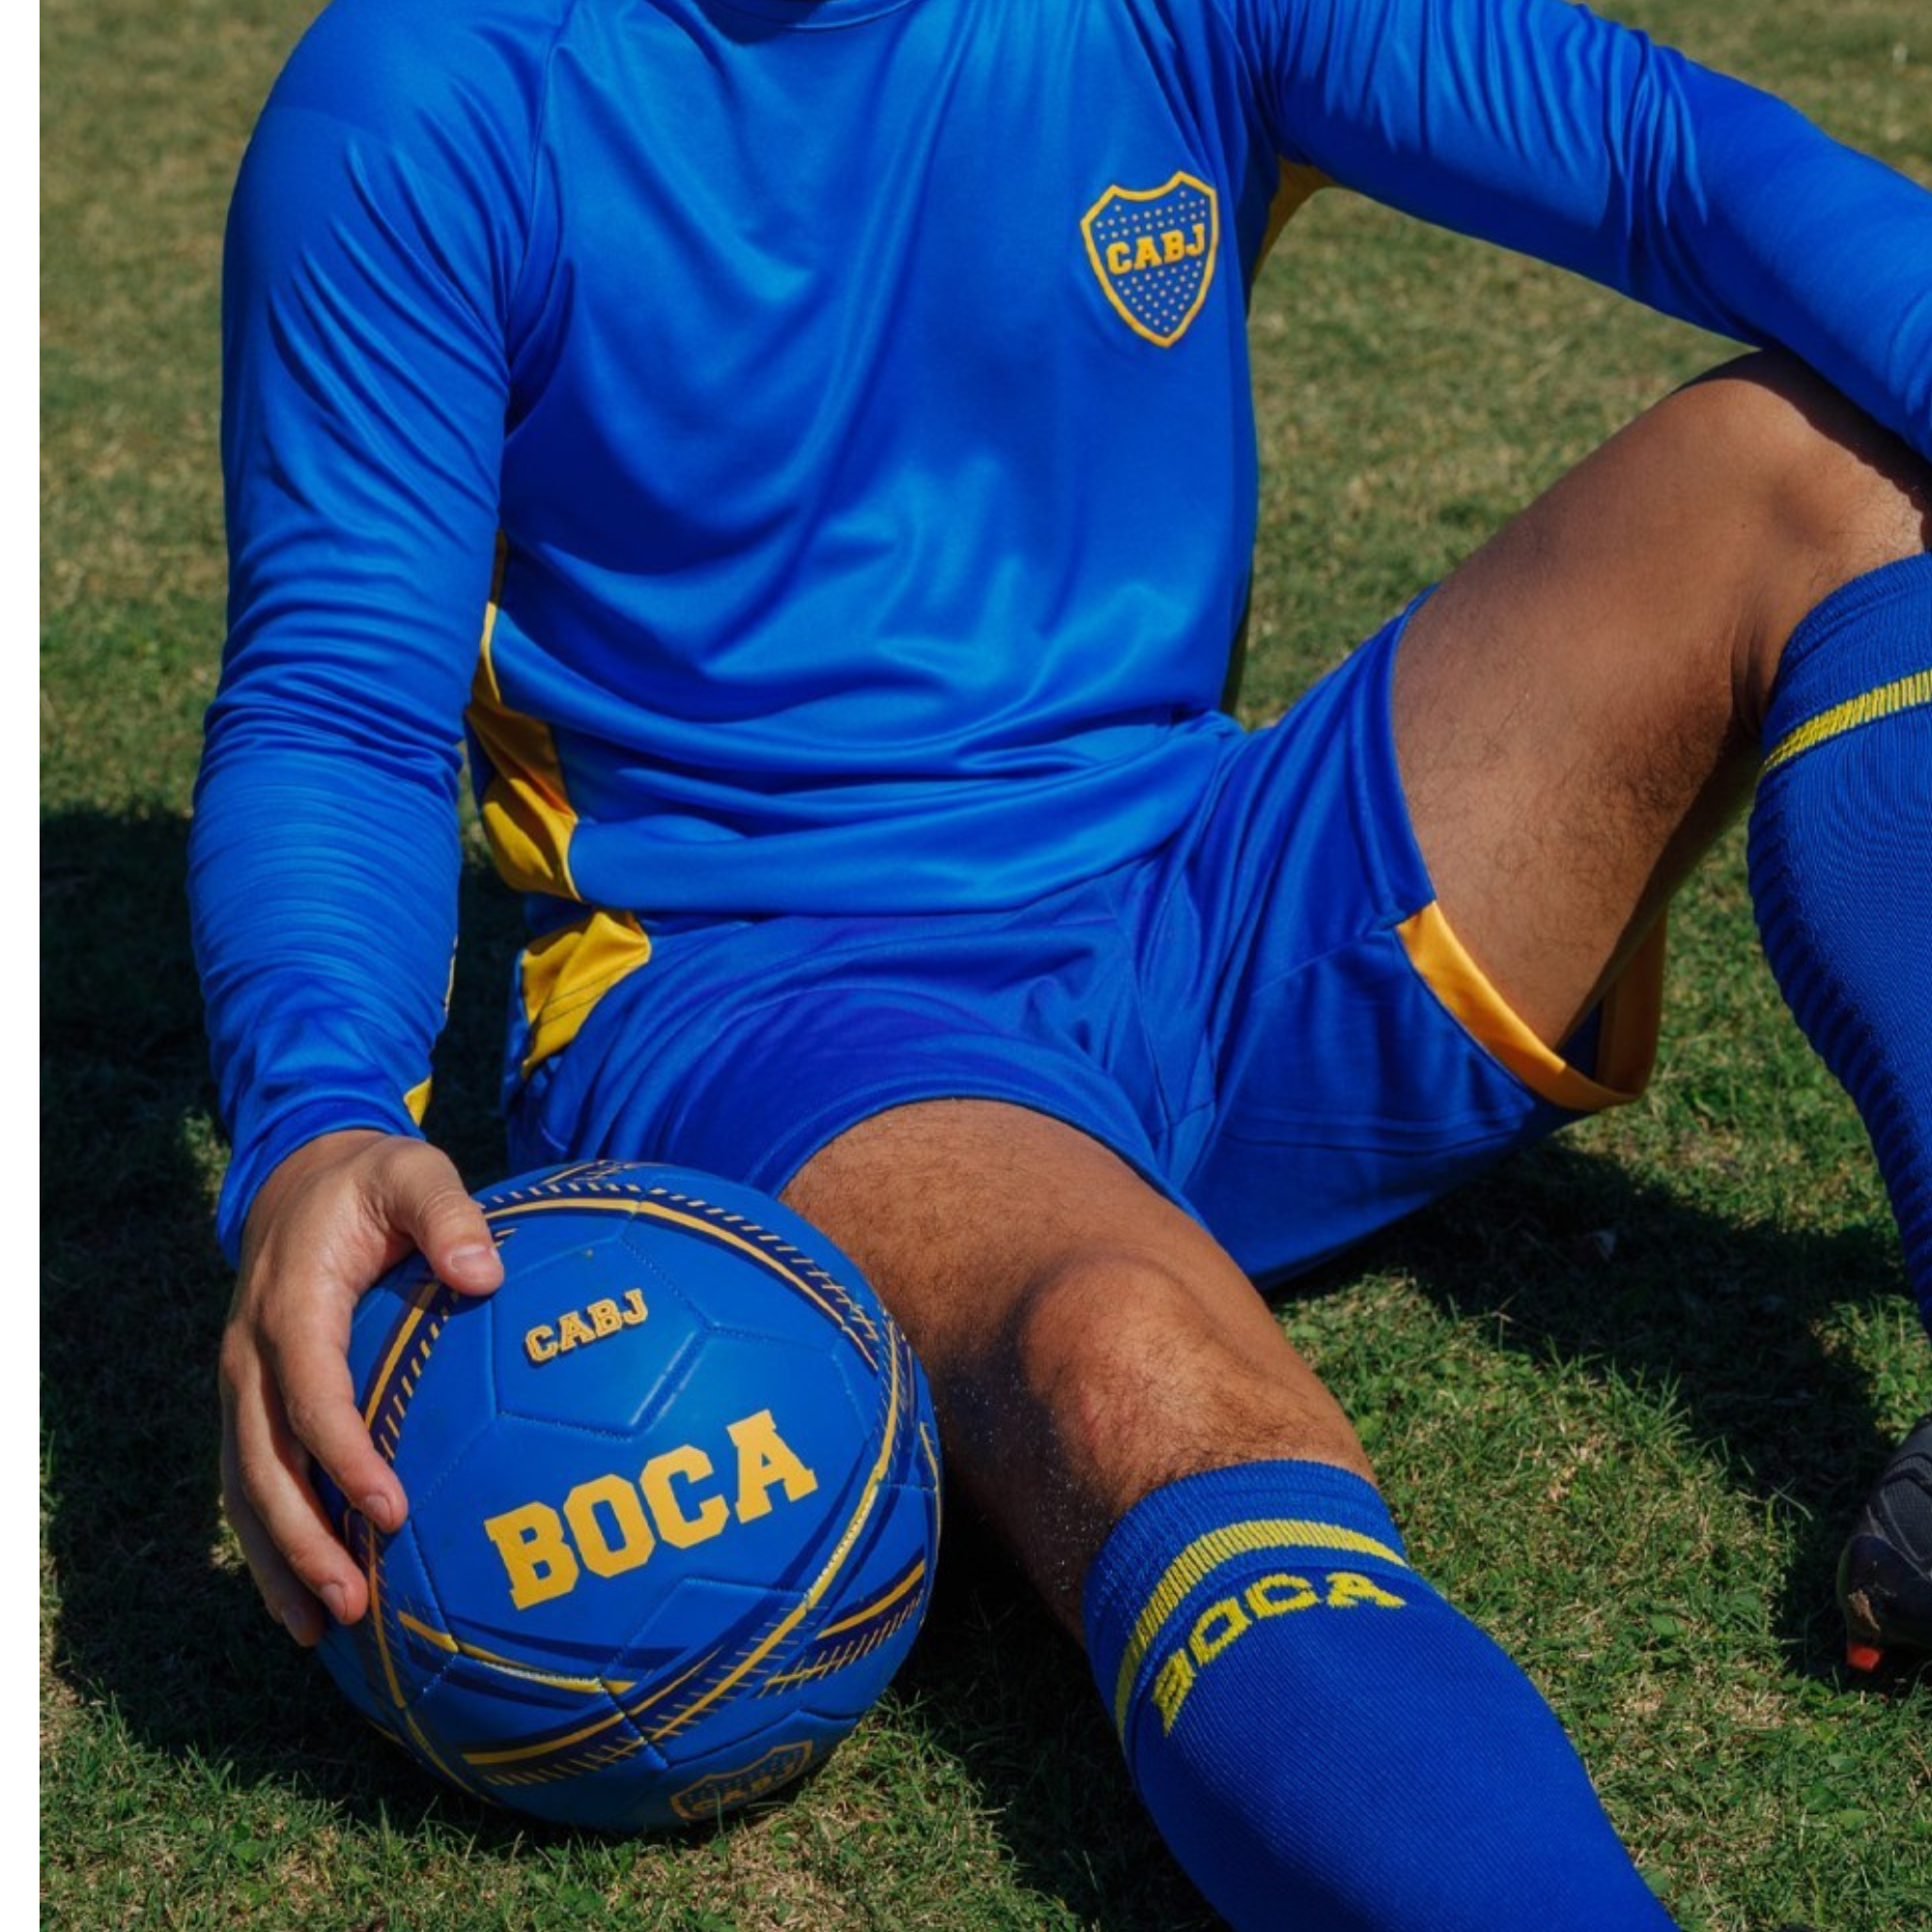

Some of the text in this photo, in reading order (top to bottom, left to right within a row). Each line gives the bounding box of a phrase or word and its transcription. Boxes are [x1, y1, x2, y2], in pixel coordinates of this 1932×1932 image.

[1106, 223, 1205, 274] CABJ
[524, 1288, 648, 1365] CABJ
[484, 1409, 818, 1610] BOCA
[1152, 1573, 1406, 1737] BOCA
